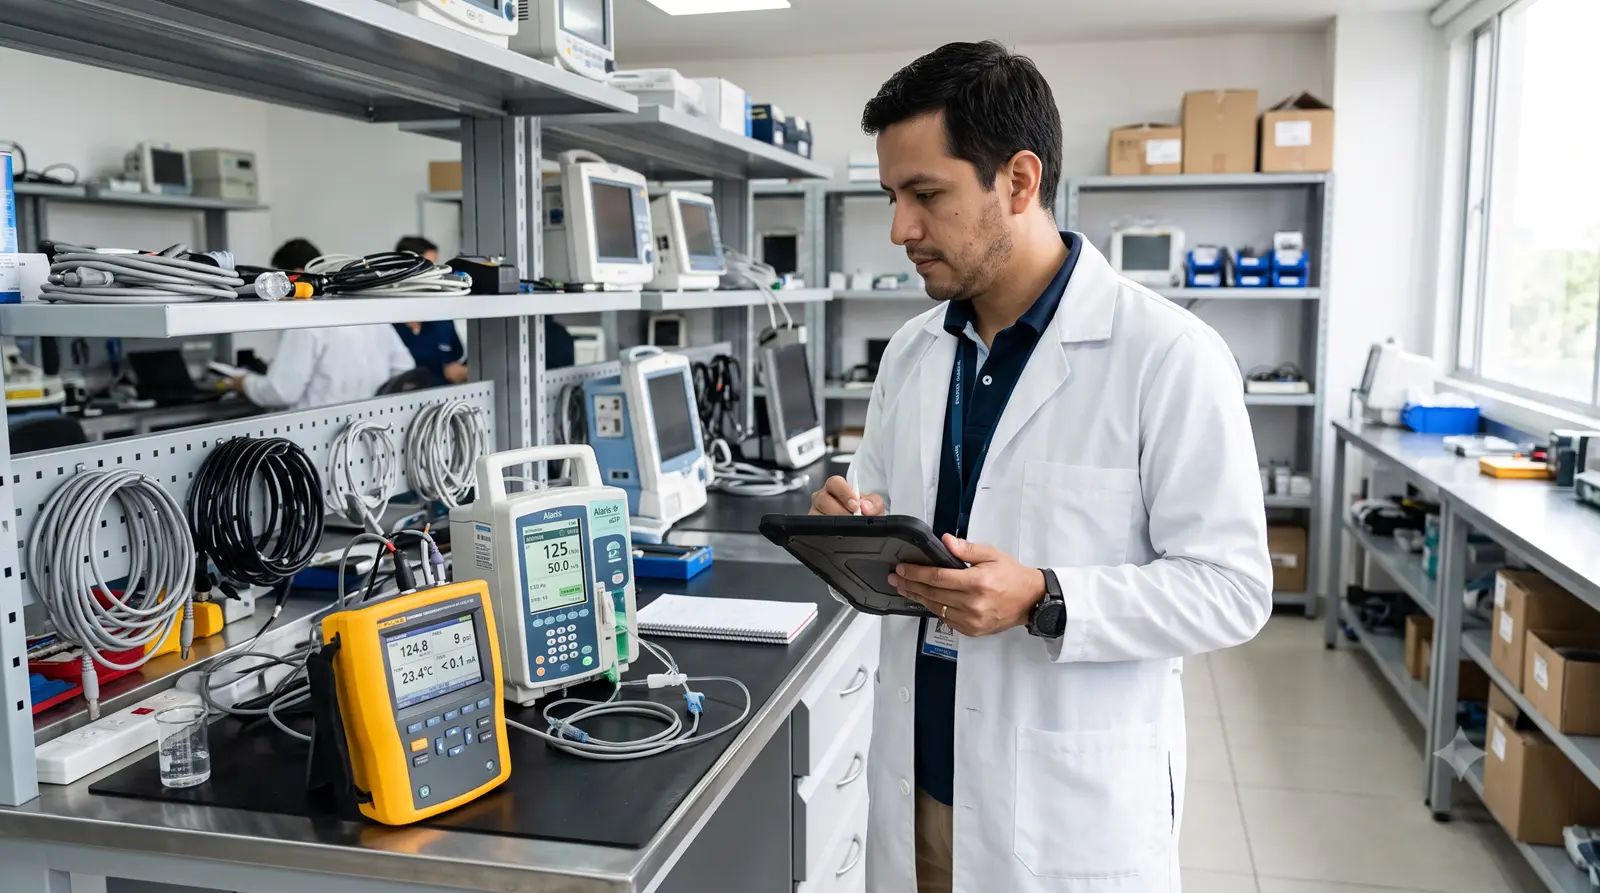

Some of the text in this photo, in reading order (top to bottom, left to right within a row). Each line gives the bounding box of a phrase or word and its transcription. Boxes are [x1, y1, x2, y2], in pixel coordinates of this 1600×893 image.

[543, 510, 562, 520] Alaris
[594, 506, 611, 516] Alaris
[544, 542, 568, 559] 125
[548, 560, 569, 574] 50.0
[454, 633, 471, 644] 9 psi
[401, 640, 428, 657] 124.8
[466, 656, 476, 664] mA
[402, 666, 433, 684] 23.4°C
